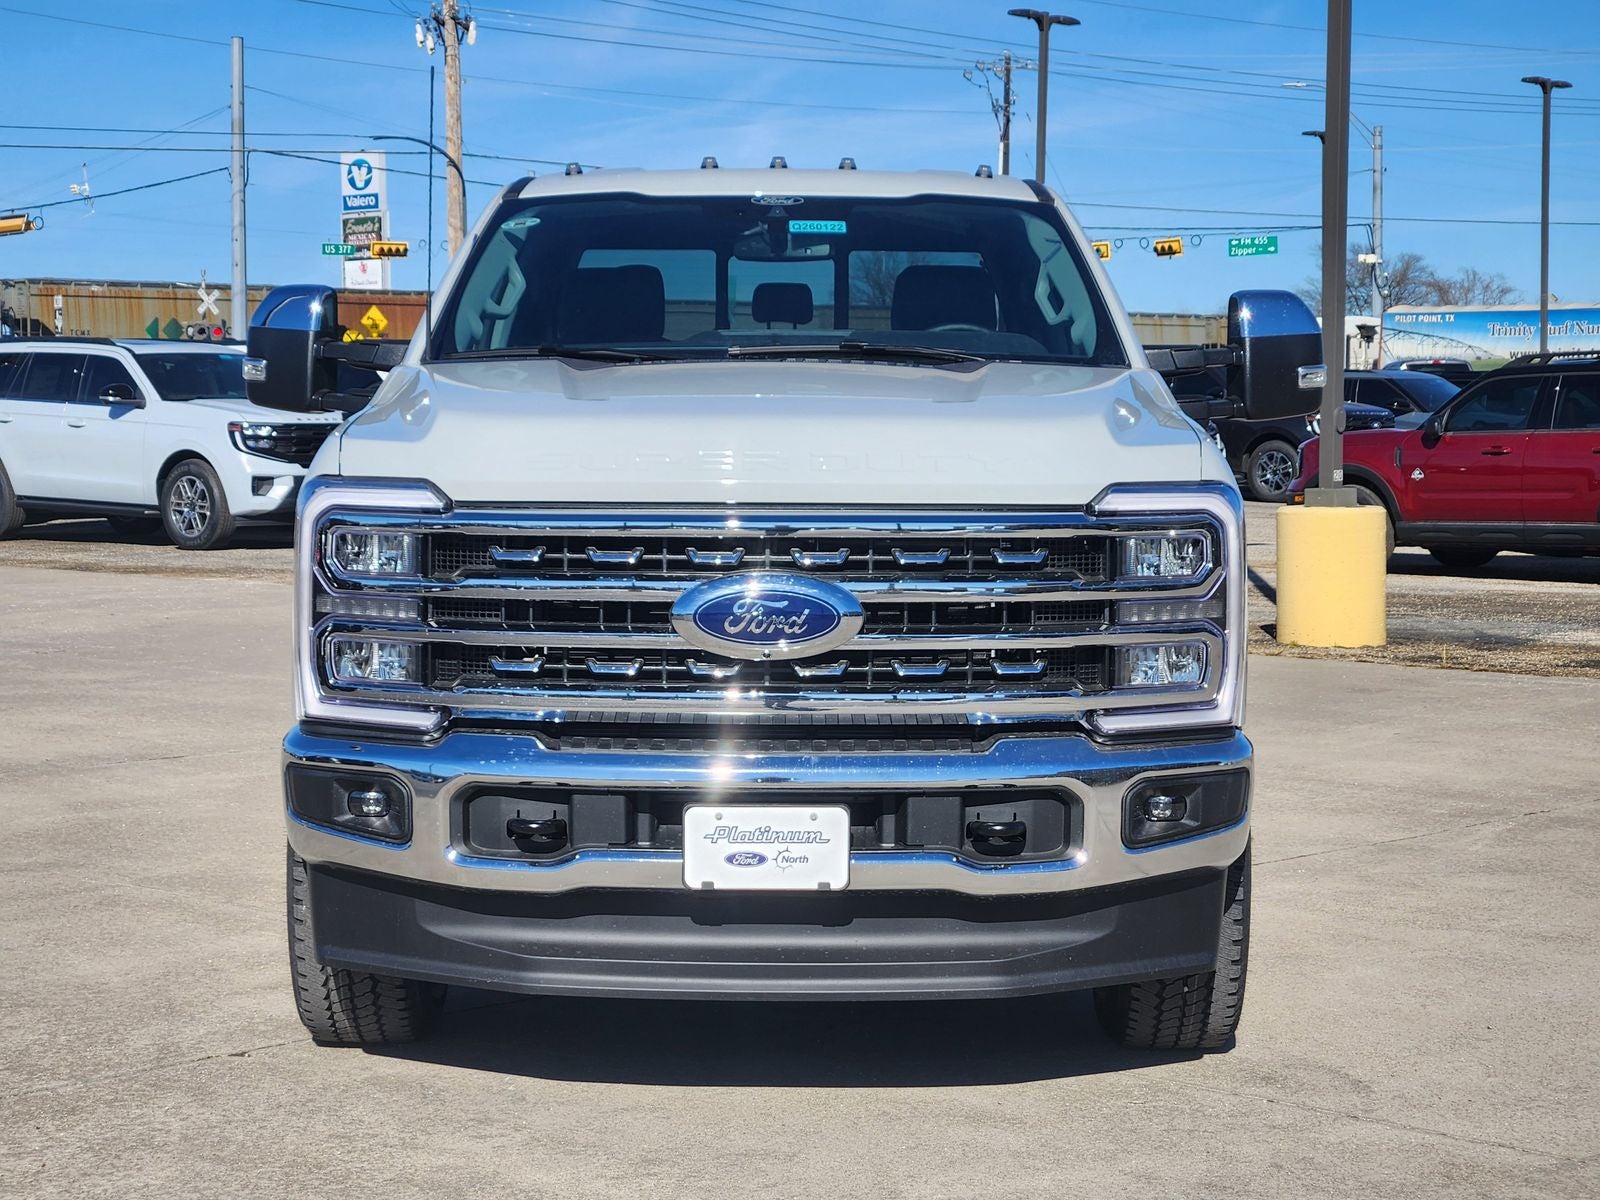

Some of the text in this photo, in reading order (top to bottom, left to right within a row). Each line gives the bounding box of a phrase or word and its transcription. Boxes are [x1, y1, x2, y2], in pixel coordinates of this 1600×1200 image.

[345, 195, 376, 207] Valero
[791, 222, 844, 231] Q260122
[1254, 236, 1267, 244] 455
[324, 245, 336, 253] US
[338, 245, 352, 254] 377
[1231, 247, 1256, 255] Zipper
[1394, 314, 1455, 323] PILOT POINT, TX
[1488, 321, 1537, 341] Trinity
[1539, 320, 1572, 336] urf
[723, 598, 811, 635] Ford
[703, 825, 831, 844] Platinum
[732, 853, 809, 866] Ford North
